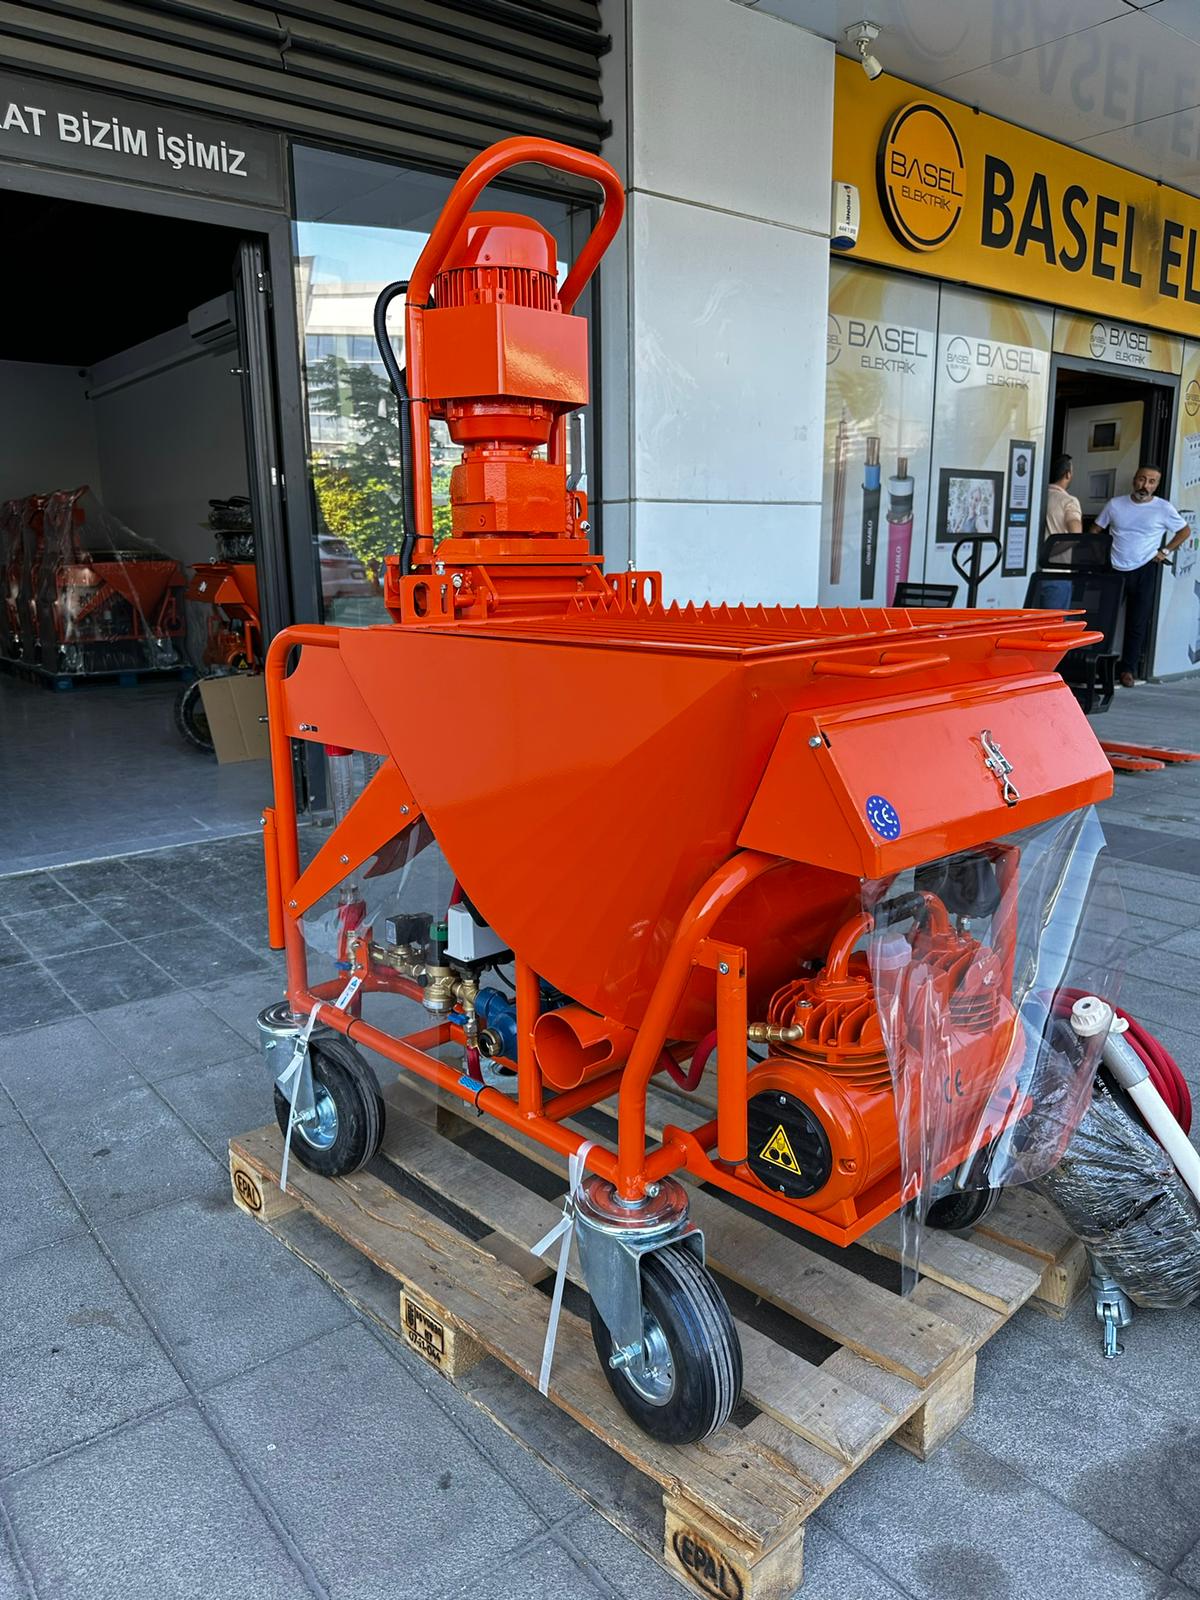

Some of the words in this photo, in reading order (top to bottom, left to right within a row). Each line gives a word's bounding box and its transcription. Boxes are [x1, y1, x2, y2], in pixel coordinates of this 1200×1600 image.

[0, 103, 46, 136] AT
[57, 111, 148, 157] BİZİM
[157, 127, 248, 177] İŞİMİZ
[891, 150, 963, 197] BASEL
[981, 154, 1142, 289] BASEL
[848, 321, 928, 358] BASEL
[976, 343, 1040, 375] BASEL
[1109, 327, 1152, 353] BASEL
[237, 1174, 258, 1207] EPAL
[681, 1535, 732, 1599] EPAL
